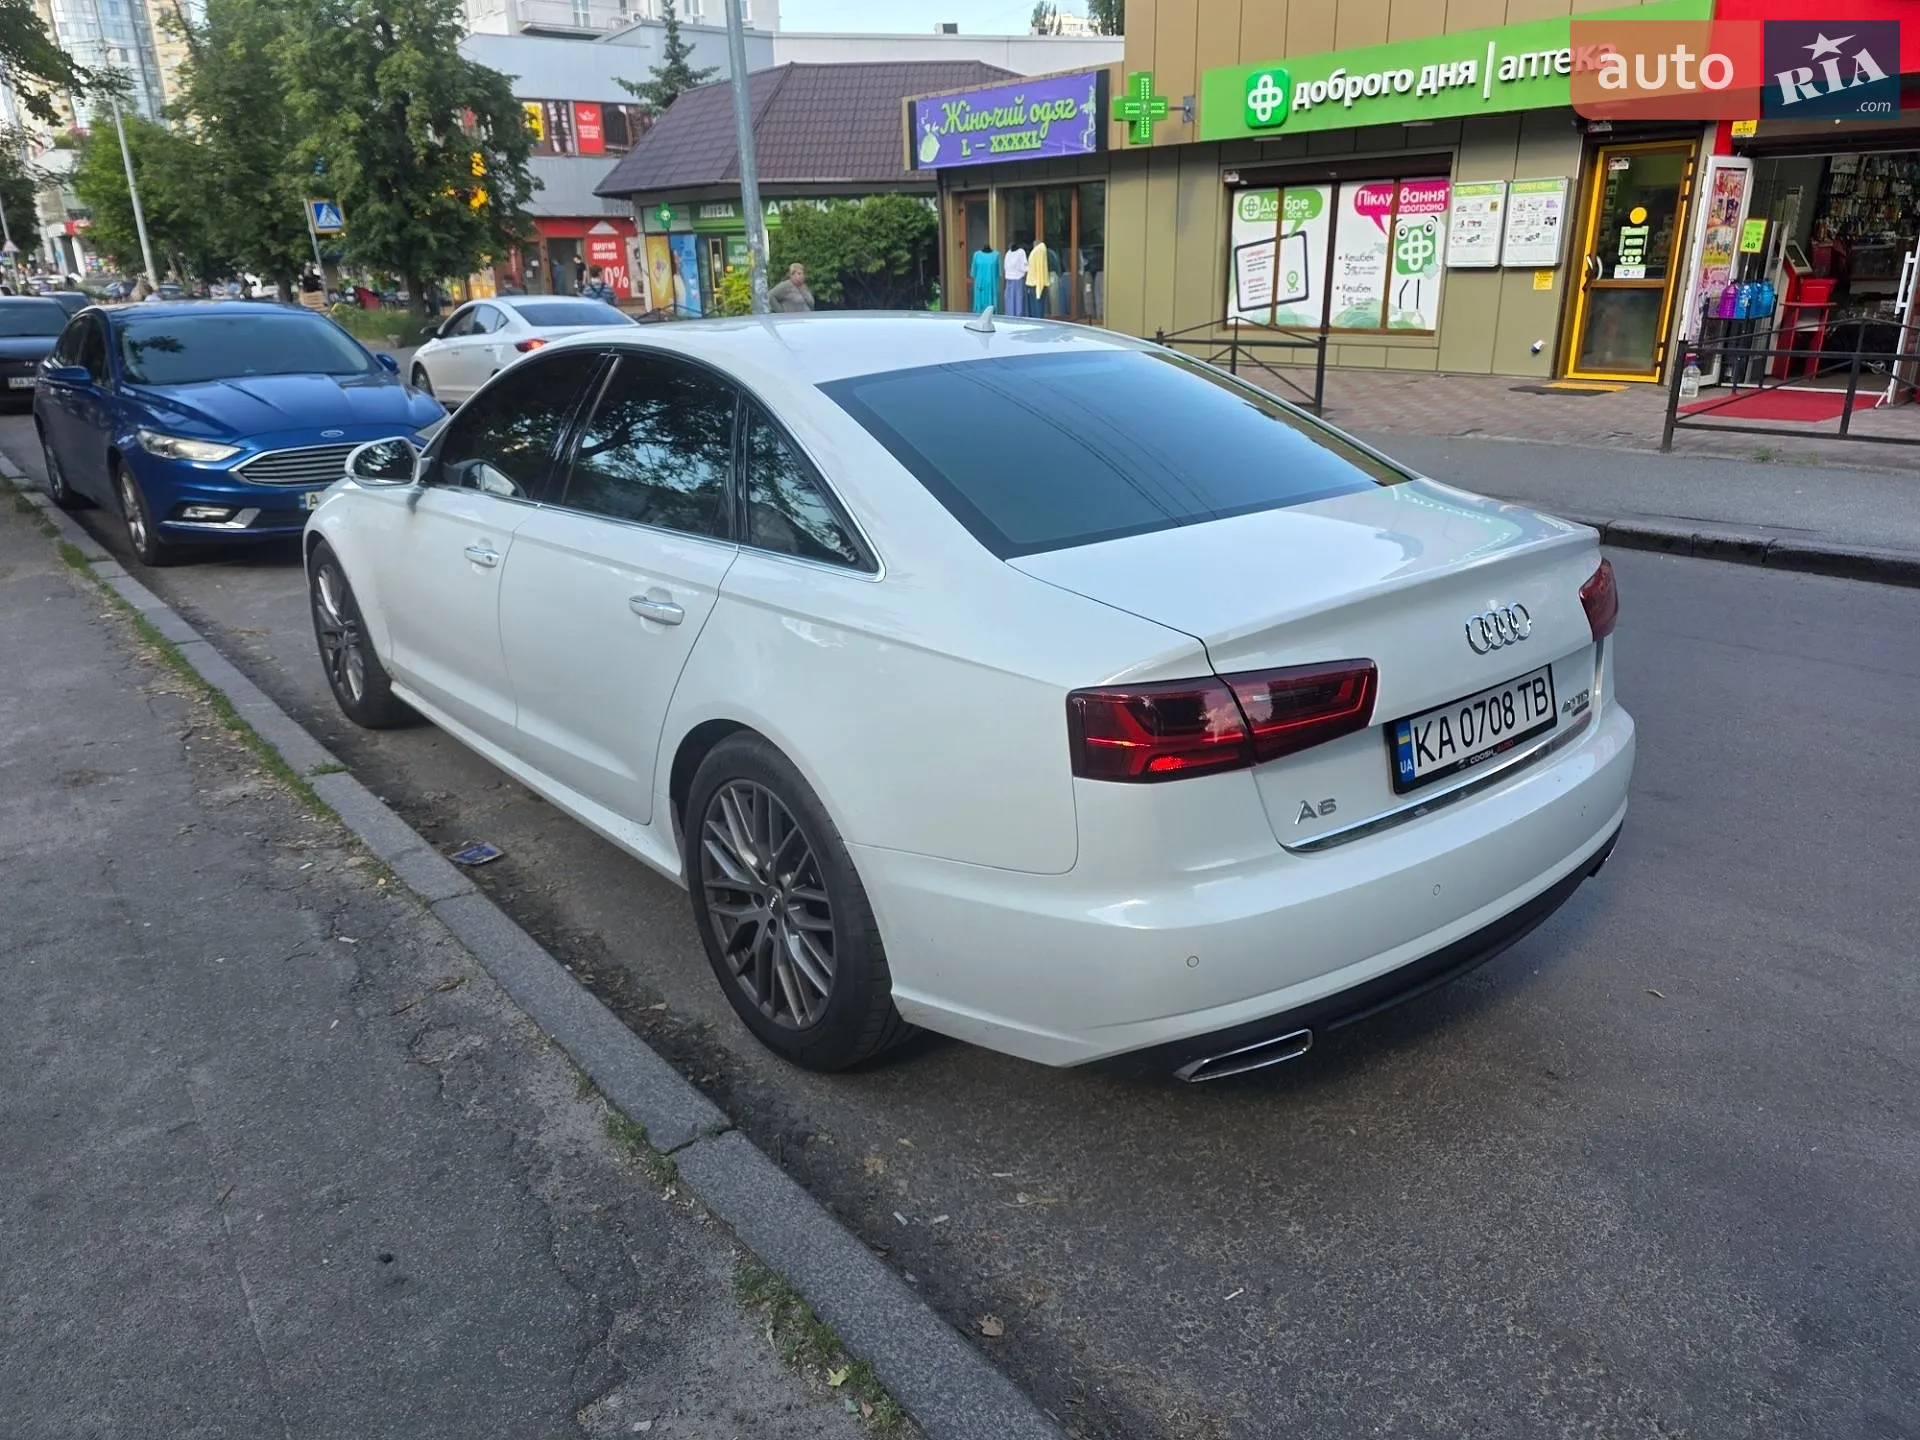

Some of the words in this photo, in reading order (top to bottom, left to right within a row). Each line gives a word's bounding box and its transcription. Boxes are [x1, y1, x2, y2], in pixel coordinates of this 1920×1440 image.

[1292, 68, 1414, 111] доброго
[1416, 60, 1478, 97] дня
[1499, 43, 1617, 82] аптека
[939, 94, 1027, 135] Жіночий
[1029, 98, 1077, 139] одяг
[961, 138, 972, 156] L
[990, 130, 1042, 153] XXXXL
[1413, 715, 1457, 768] KA
[1459, 691, 1516, 749] 0708
[1517, 676, 1549, 723] TB
[1400, 757, 1414, 774] UA
[1294, 798, 1337, 825] A6
